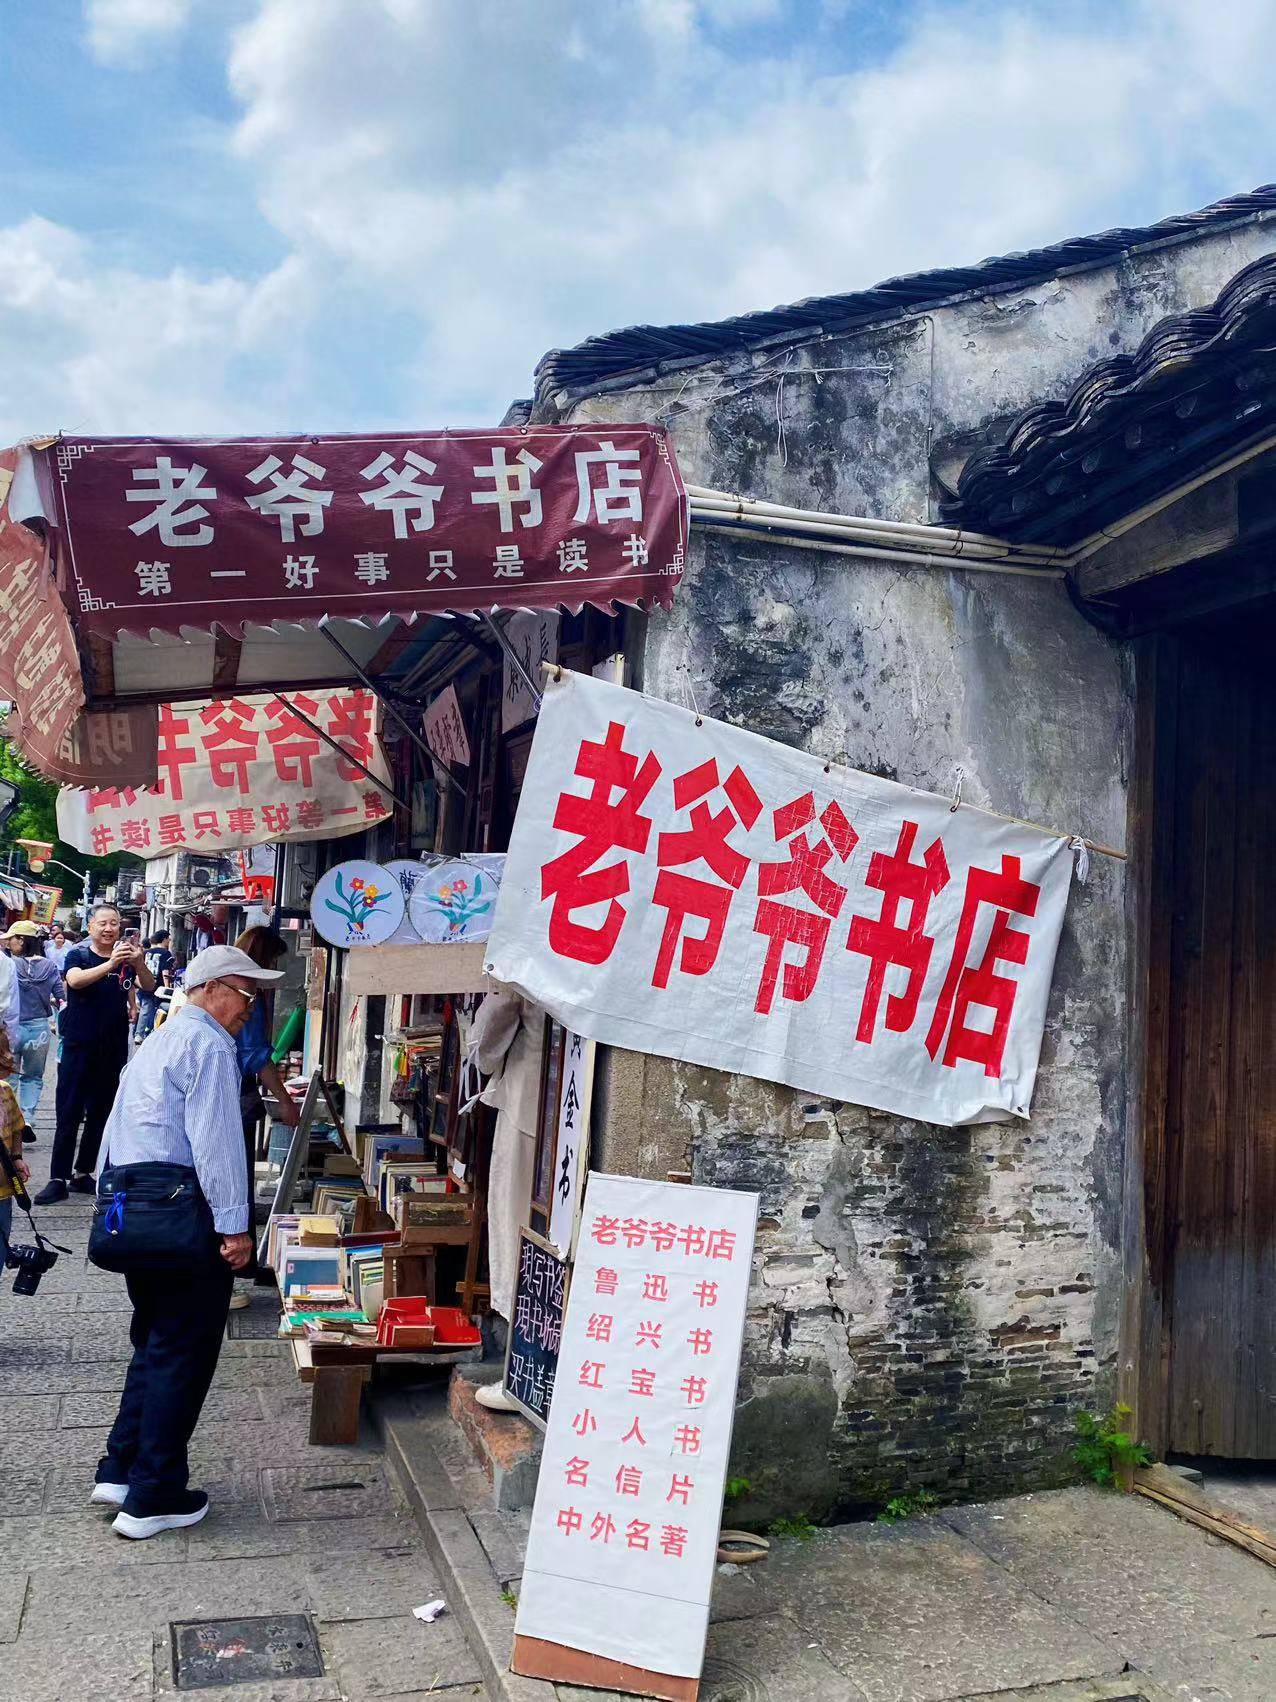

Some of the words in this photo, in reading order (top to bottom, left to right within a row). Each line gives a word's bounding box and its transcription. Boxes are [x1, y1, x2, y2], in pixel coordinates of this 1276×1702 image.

[125, 441, 644, 547] 老爷爷书店
[135, 534, 650, 596] 第一好事只是读书
[541, 721, 1041, 1079] 老爷爷书店
[591, 1215, 737, 1261] 老爷爷书店
[593, 1267, 719, 1308] 鲁迅书
[585, 1312, 713, 1356] 绍兴书
[577, 1359, 707, 1405] 红宝书
[571, 1407, 701, 1455] 小人书
[563, 1455, 694, 1506] 名信片
[556, 1505, 689, 1558] 中外名著
